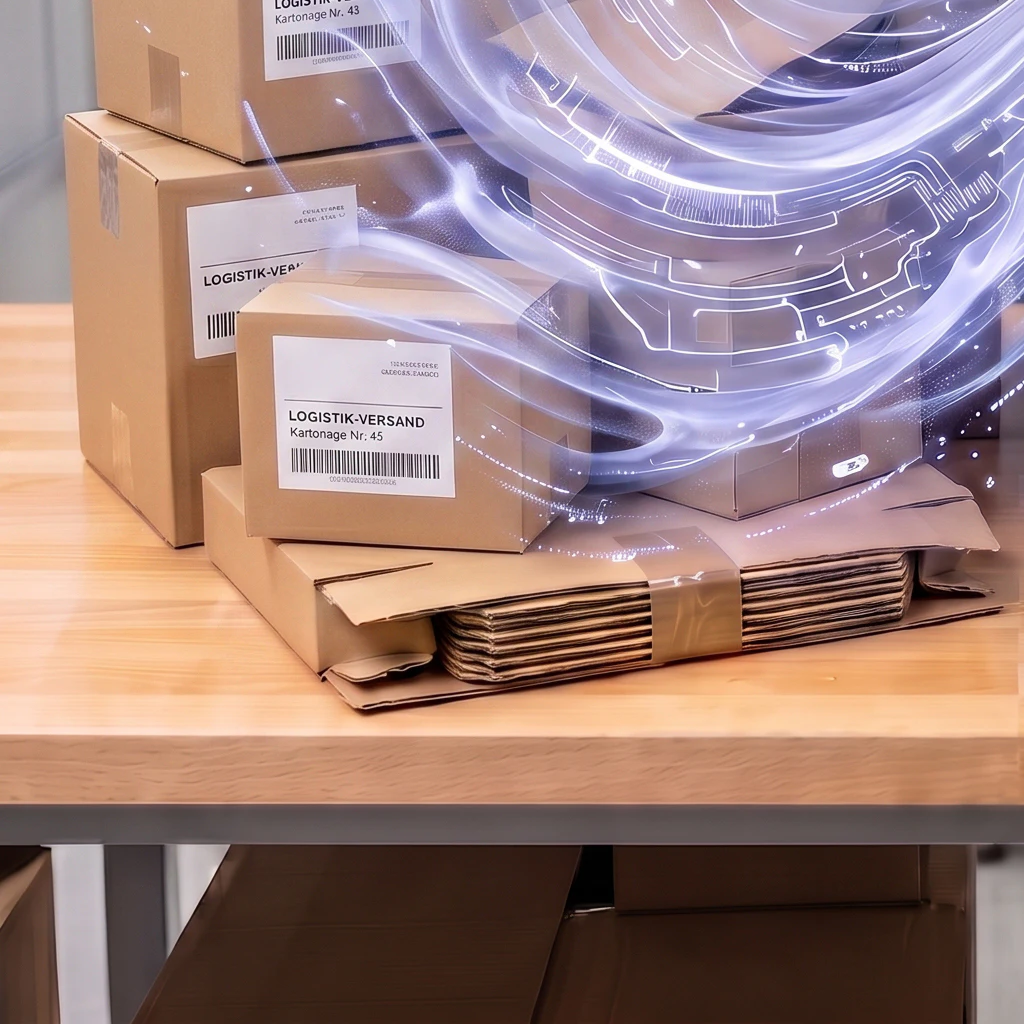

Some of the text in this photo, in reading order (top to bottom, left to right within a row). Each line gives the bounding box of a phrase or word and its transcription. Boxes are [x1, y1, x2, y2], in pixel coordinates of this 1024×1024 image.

[275, 5, 360, 25] Kartonage Nr. 43
[203, 262, 304, 287] LOGISTIK-VE
[289, 410, 425, 428] LOGISTIK-VERSAND
[290, 427, 347, 442] Kartonage
[370, 431, 383, 442] 45
